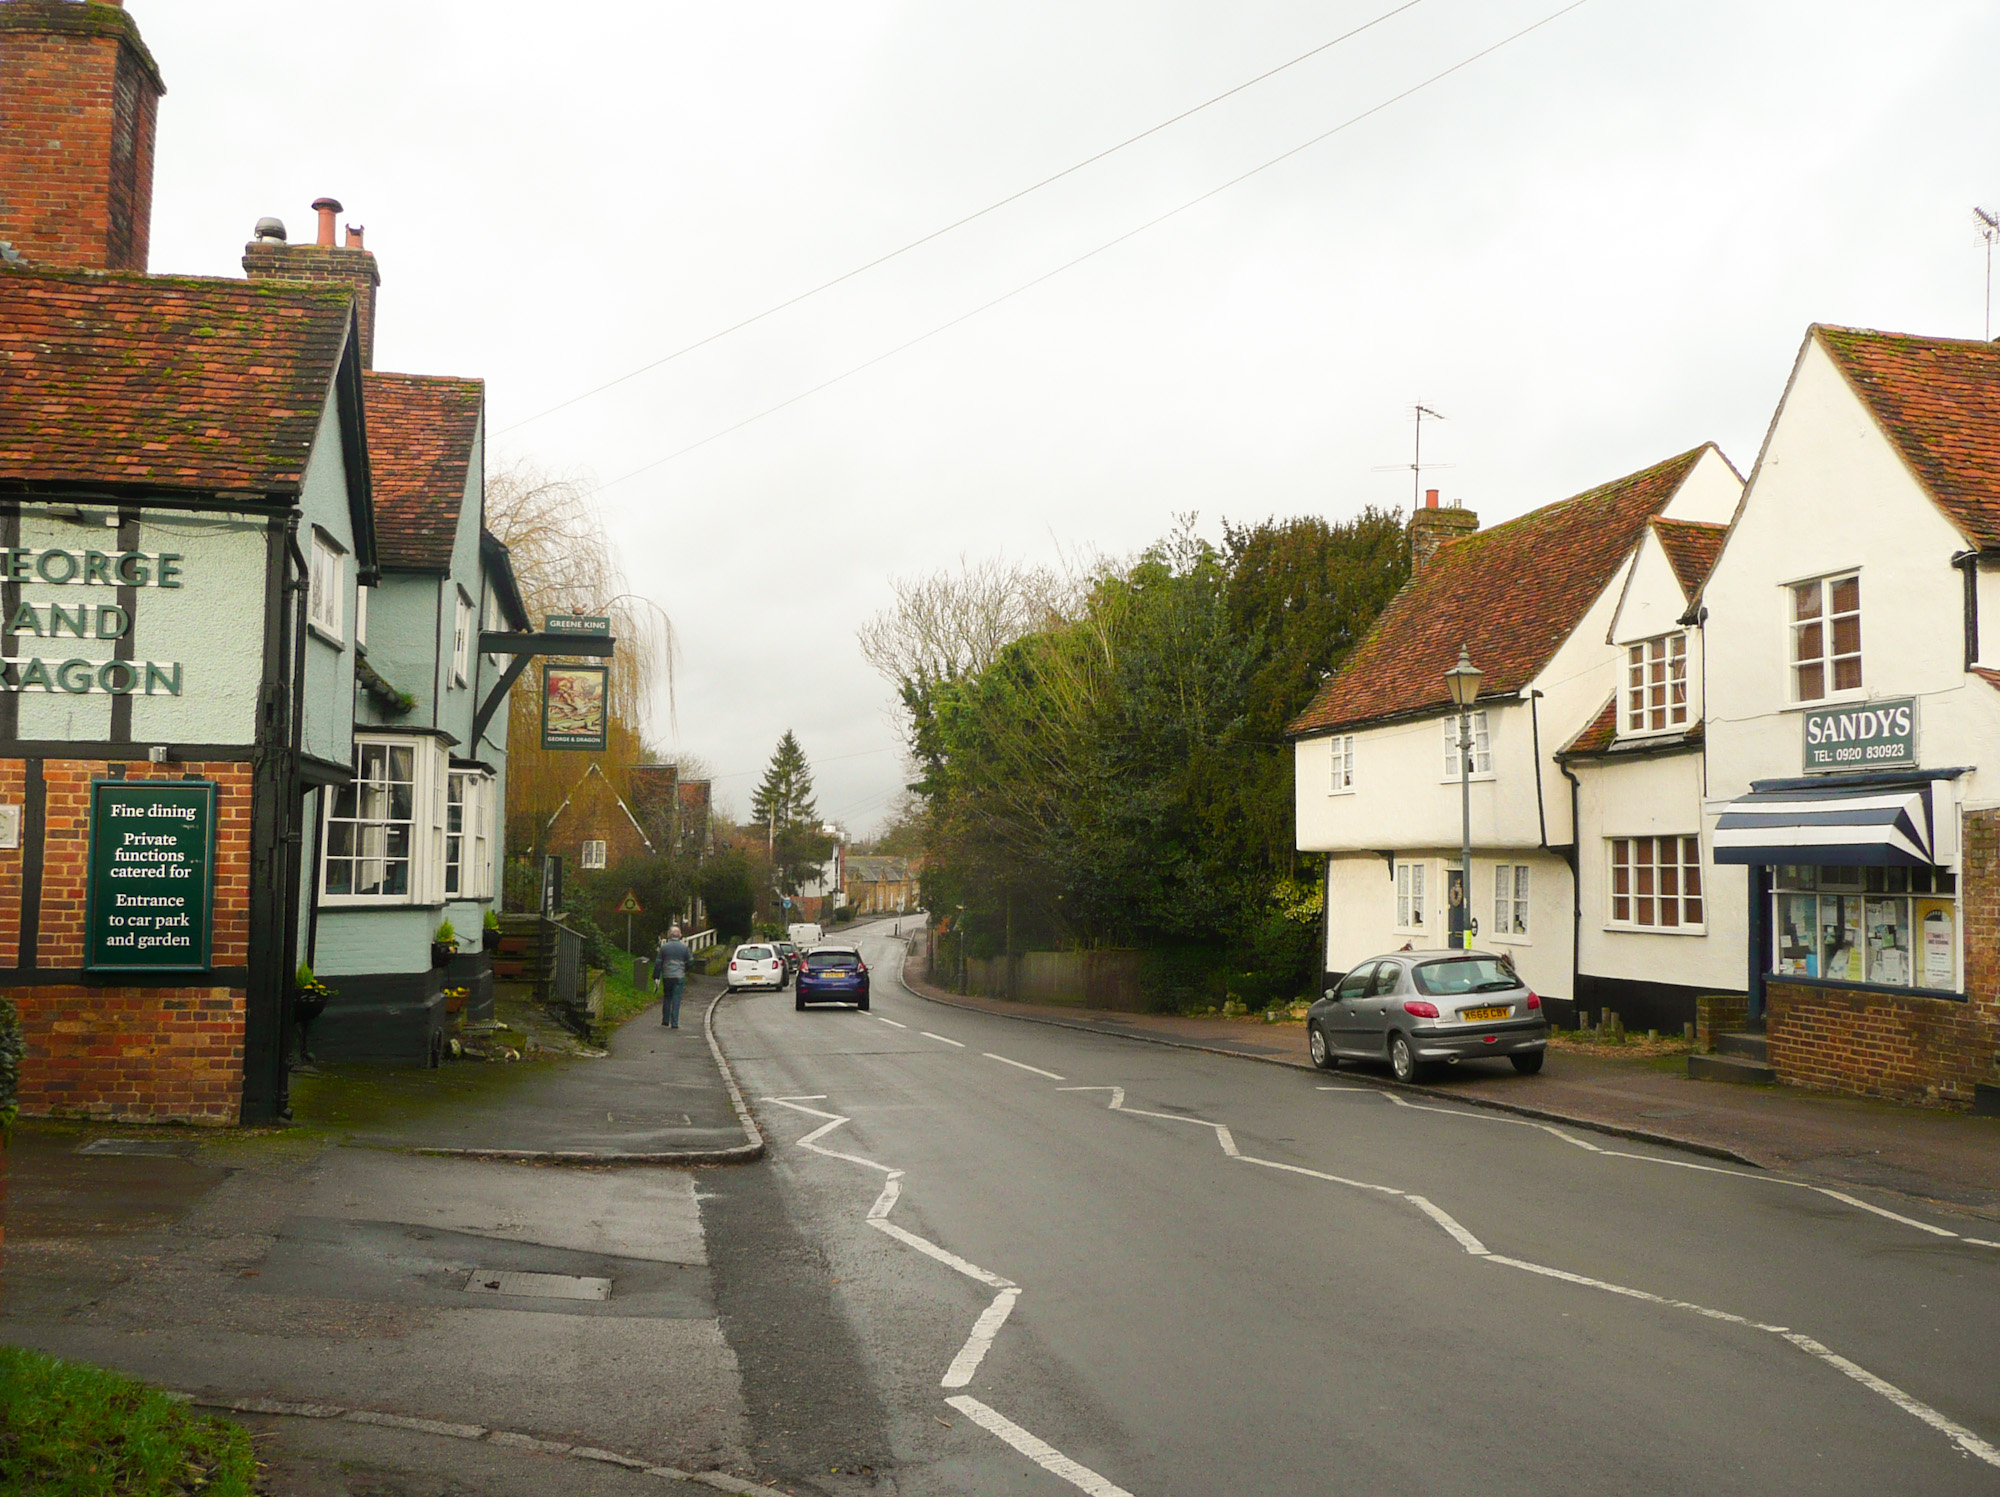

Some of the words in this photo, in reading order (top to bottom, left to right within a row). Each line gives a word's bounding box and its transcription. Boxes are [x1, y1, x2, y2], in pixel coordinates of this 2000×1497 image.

[6, 602, 129, 640] AND
[549, 620, 583, 628] GREENE
[584, 621, 606, 629] KING
[1807, 706, 1911, 745] SANDYS
[1836, 747, 1862, 761] 0920
[1866, 743, 1905, 759] 830923
[110, 803, 145, 818] Fine
[147, 803, 197, 821] dining
[123, 831, 178, 846] Private
[115, 847, 185, 862] functions
[110, 864, 166, 879] catered
[169, 864, 192, 879] for
[115, 893, 185, 907] Entrance
[108, 915, 124, 927] to
[127, 915, 153, 927] car
[155, 912, 190, 930] park
[106, 931, 135, 947] and
[138, 932, 190, 950] garden
[1491, 1007, 1507, 1017] CBY
